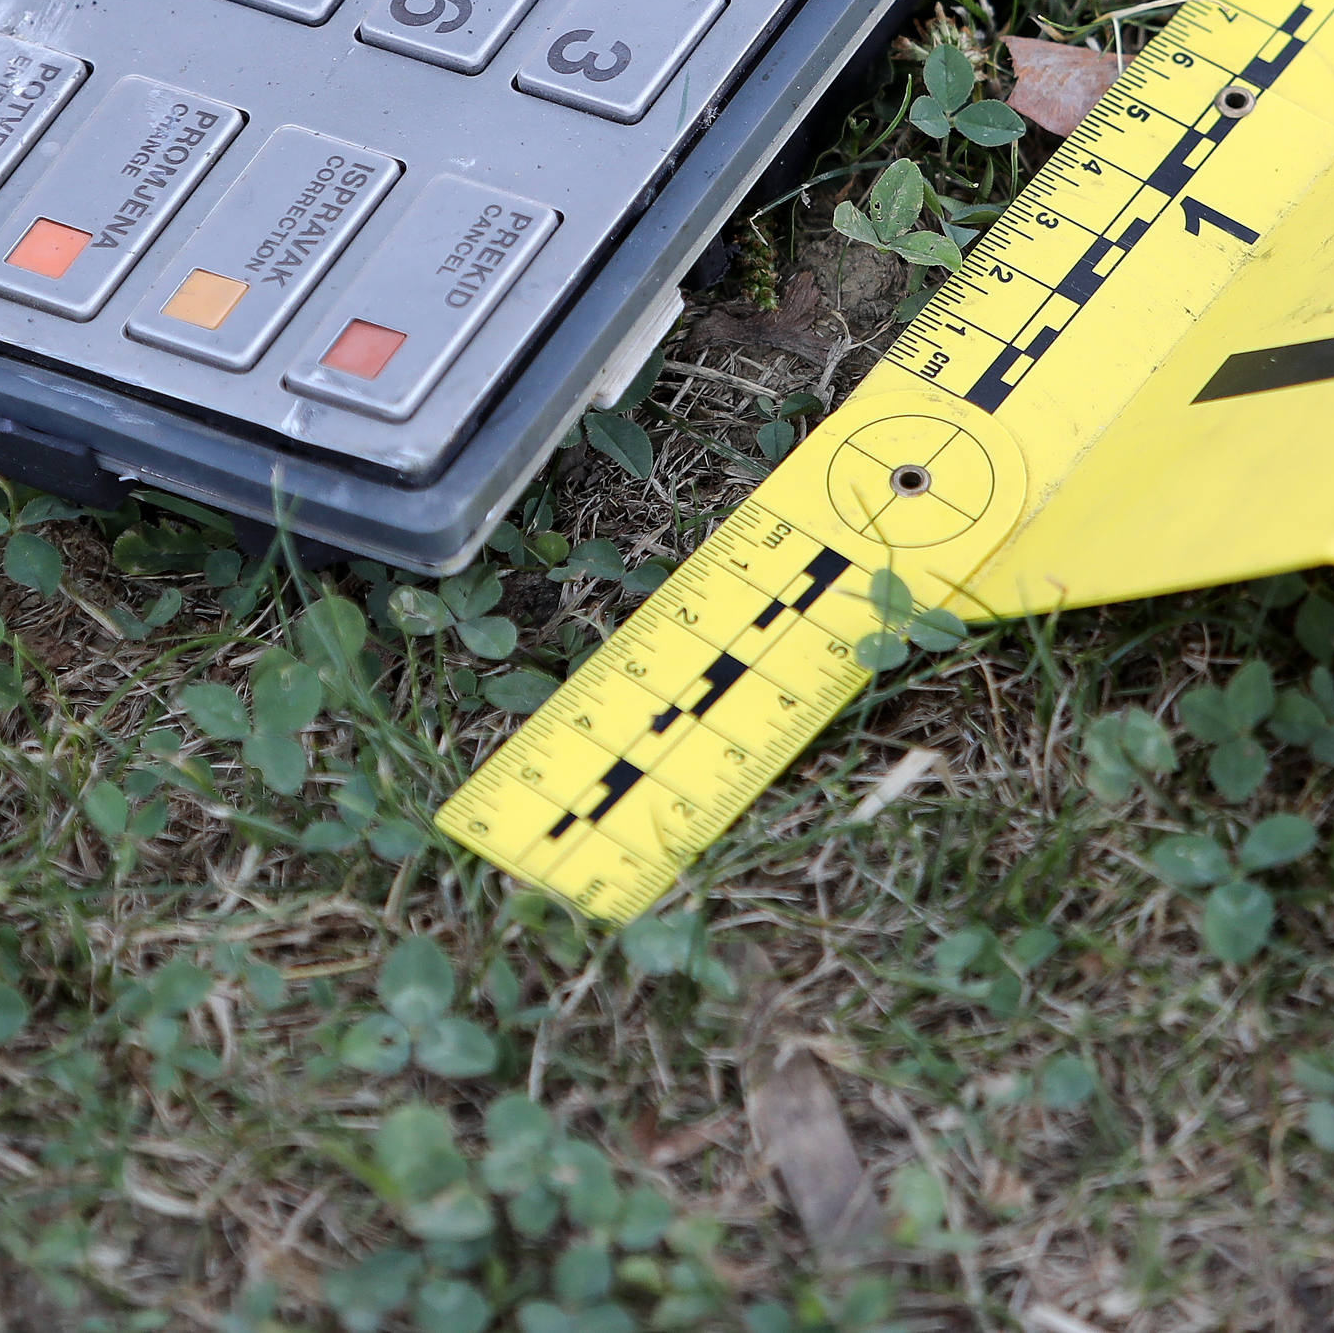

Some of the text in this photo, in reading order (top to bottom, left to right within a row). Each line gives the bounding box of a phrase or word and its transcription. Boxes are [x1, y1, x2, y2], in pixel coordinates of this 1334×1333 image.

[1218, 6, 1238, 23] 7
[547, 29, 631, 82] 3
[1172, 52, 1194, 69] 6
[1126, 103, 1150, 123] 5
[120, 103, 189, 178] CHANGE
[1081, 160, 1102, 177] 4
[90, 110, 220, 250] PROMJENA
[244, 155, 345, 272] CORRECTION
[1035, 211, 1059, 230] 3
[1180, 195, 1261, 246] 1
[260, 162, 376, 288] ISPRAVAK
[435, 204, 502, 276] CANCEL
[444, 211, 533, 309] PREKID
[988, 265, 1013, 284] 2
[945, 323, 966, 338] 1
[919, 350, 951, 380] cm
[763, 522, 793, 551] cm
[728, 557, 749, 573] 1
[675, 606, 700, 626] 2
[827, 640, 849, 660] 5
[624, 659, 648, 680] 3
[776, 693, 797, 712] 4
[571, 713, 593, 733] 4
[723, 746, 747, 767] 3
[521, 765, 544, 786] 5
